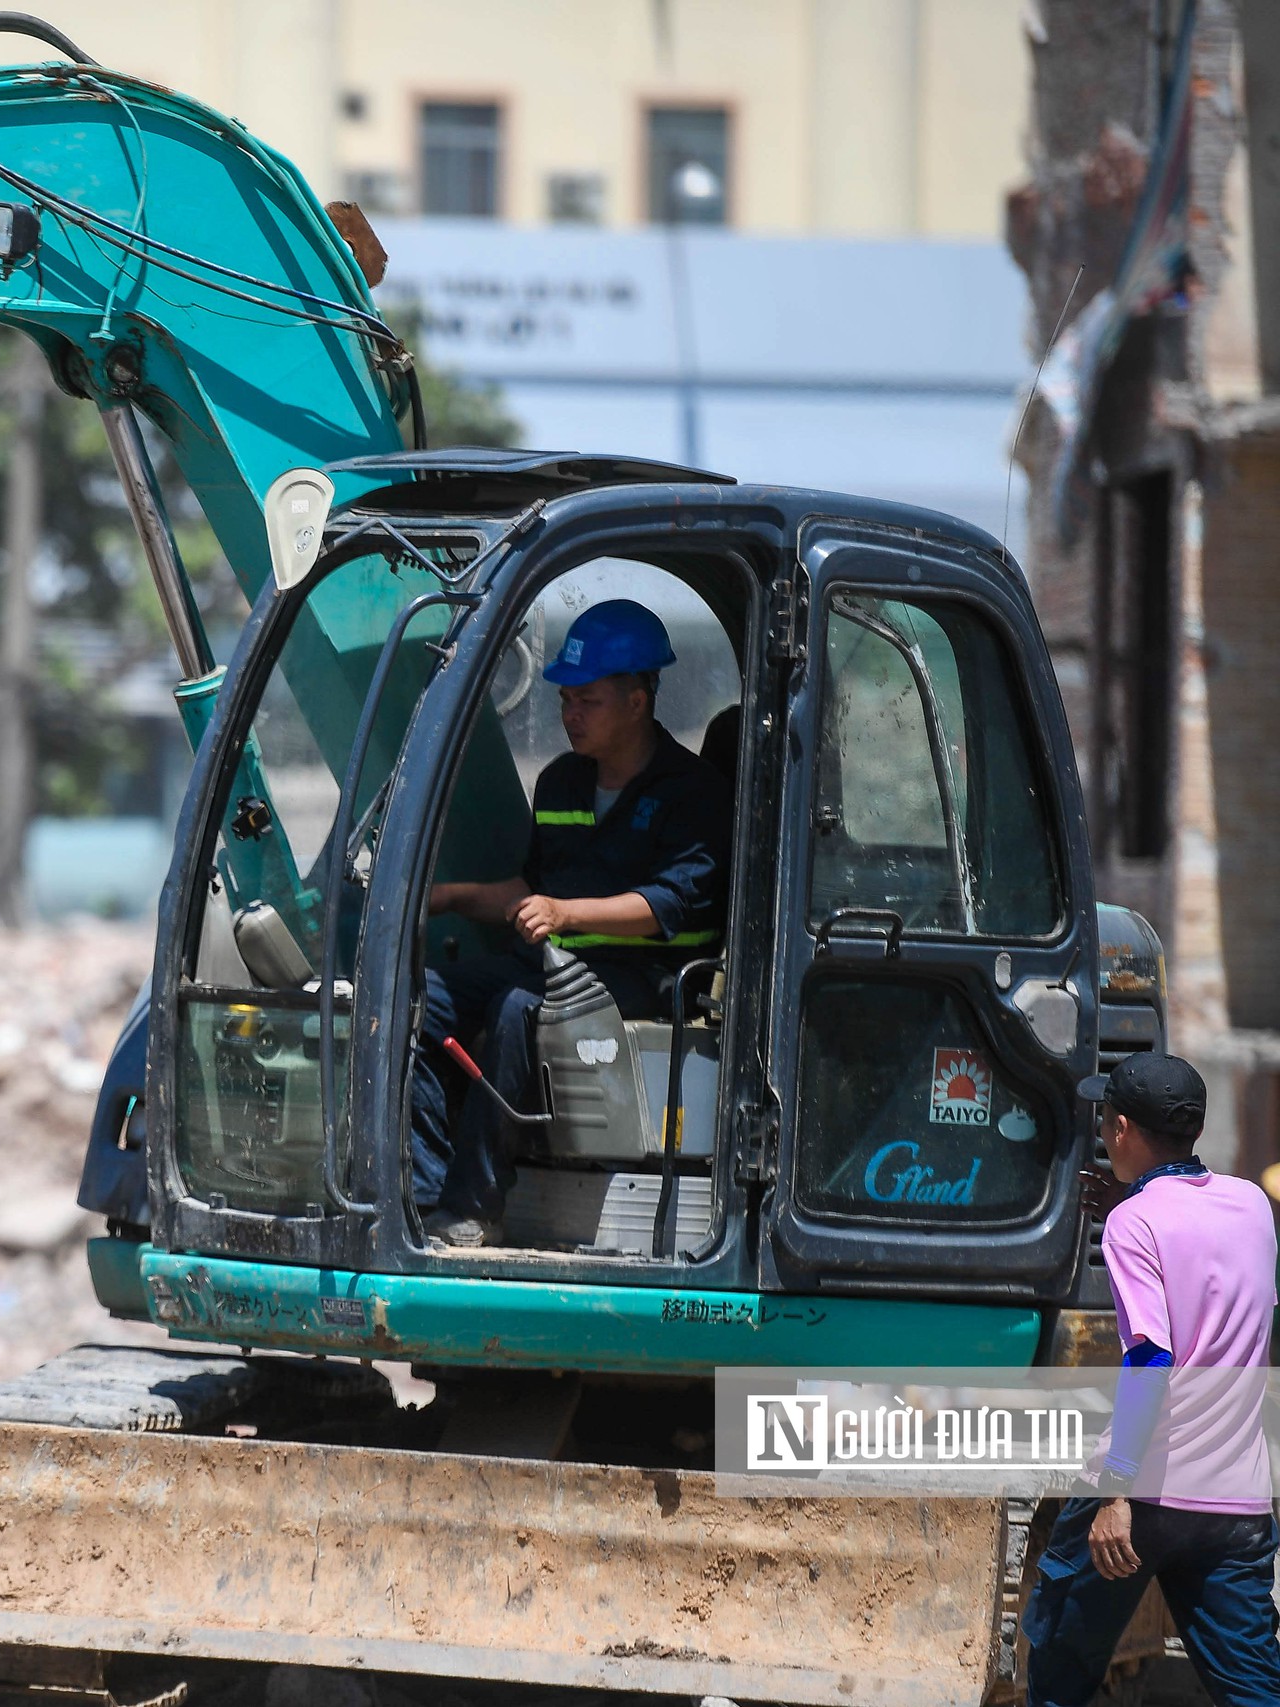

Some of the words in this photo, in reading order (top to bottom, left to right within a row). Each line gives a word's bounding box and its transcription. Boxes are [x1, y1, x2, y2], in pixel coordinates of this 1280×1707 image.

[933, 1106, 988, 1123] TAIYO
[661, 1298, 827, 1328] 移動式クレーン
